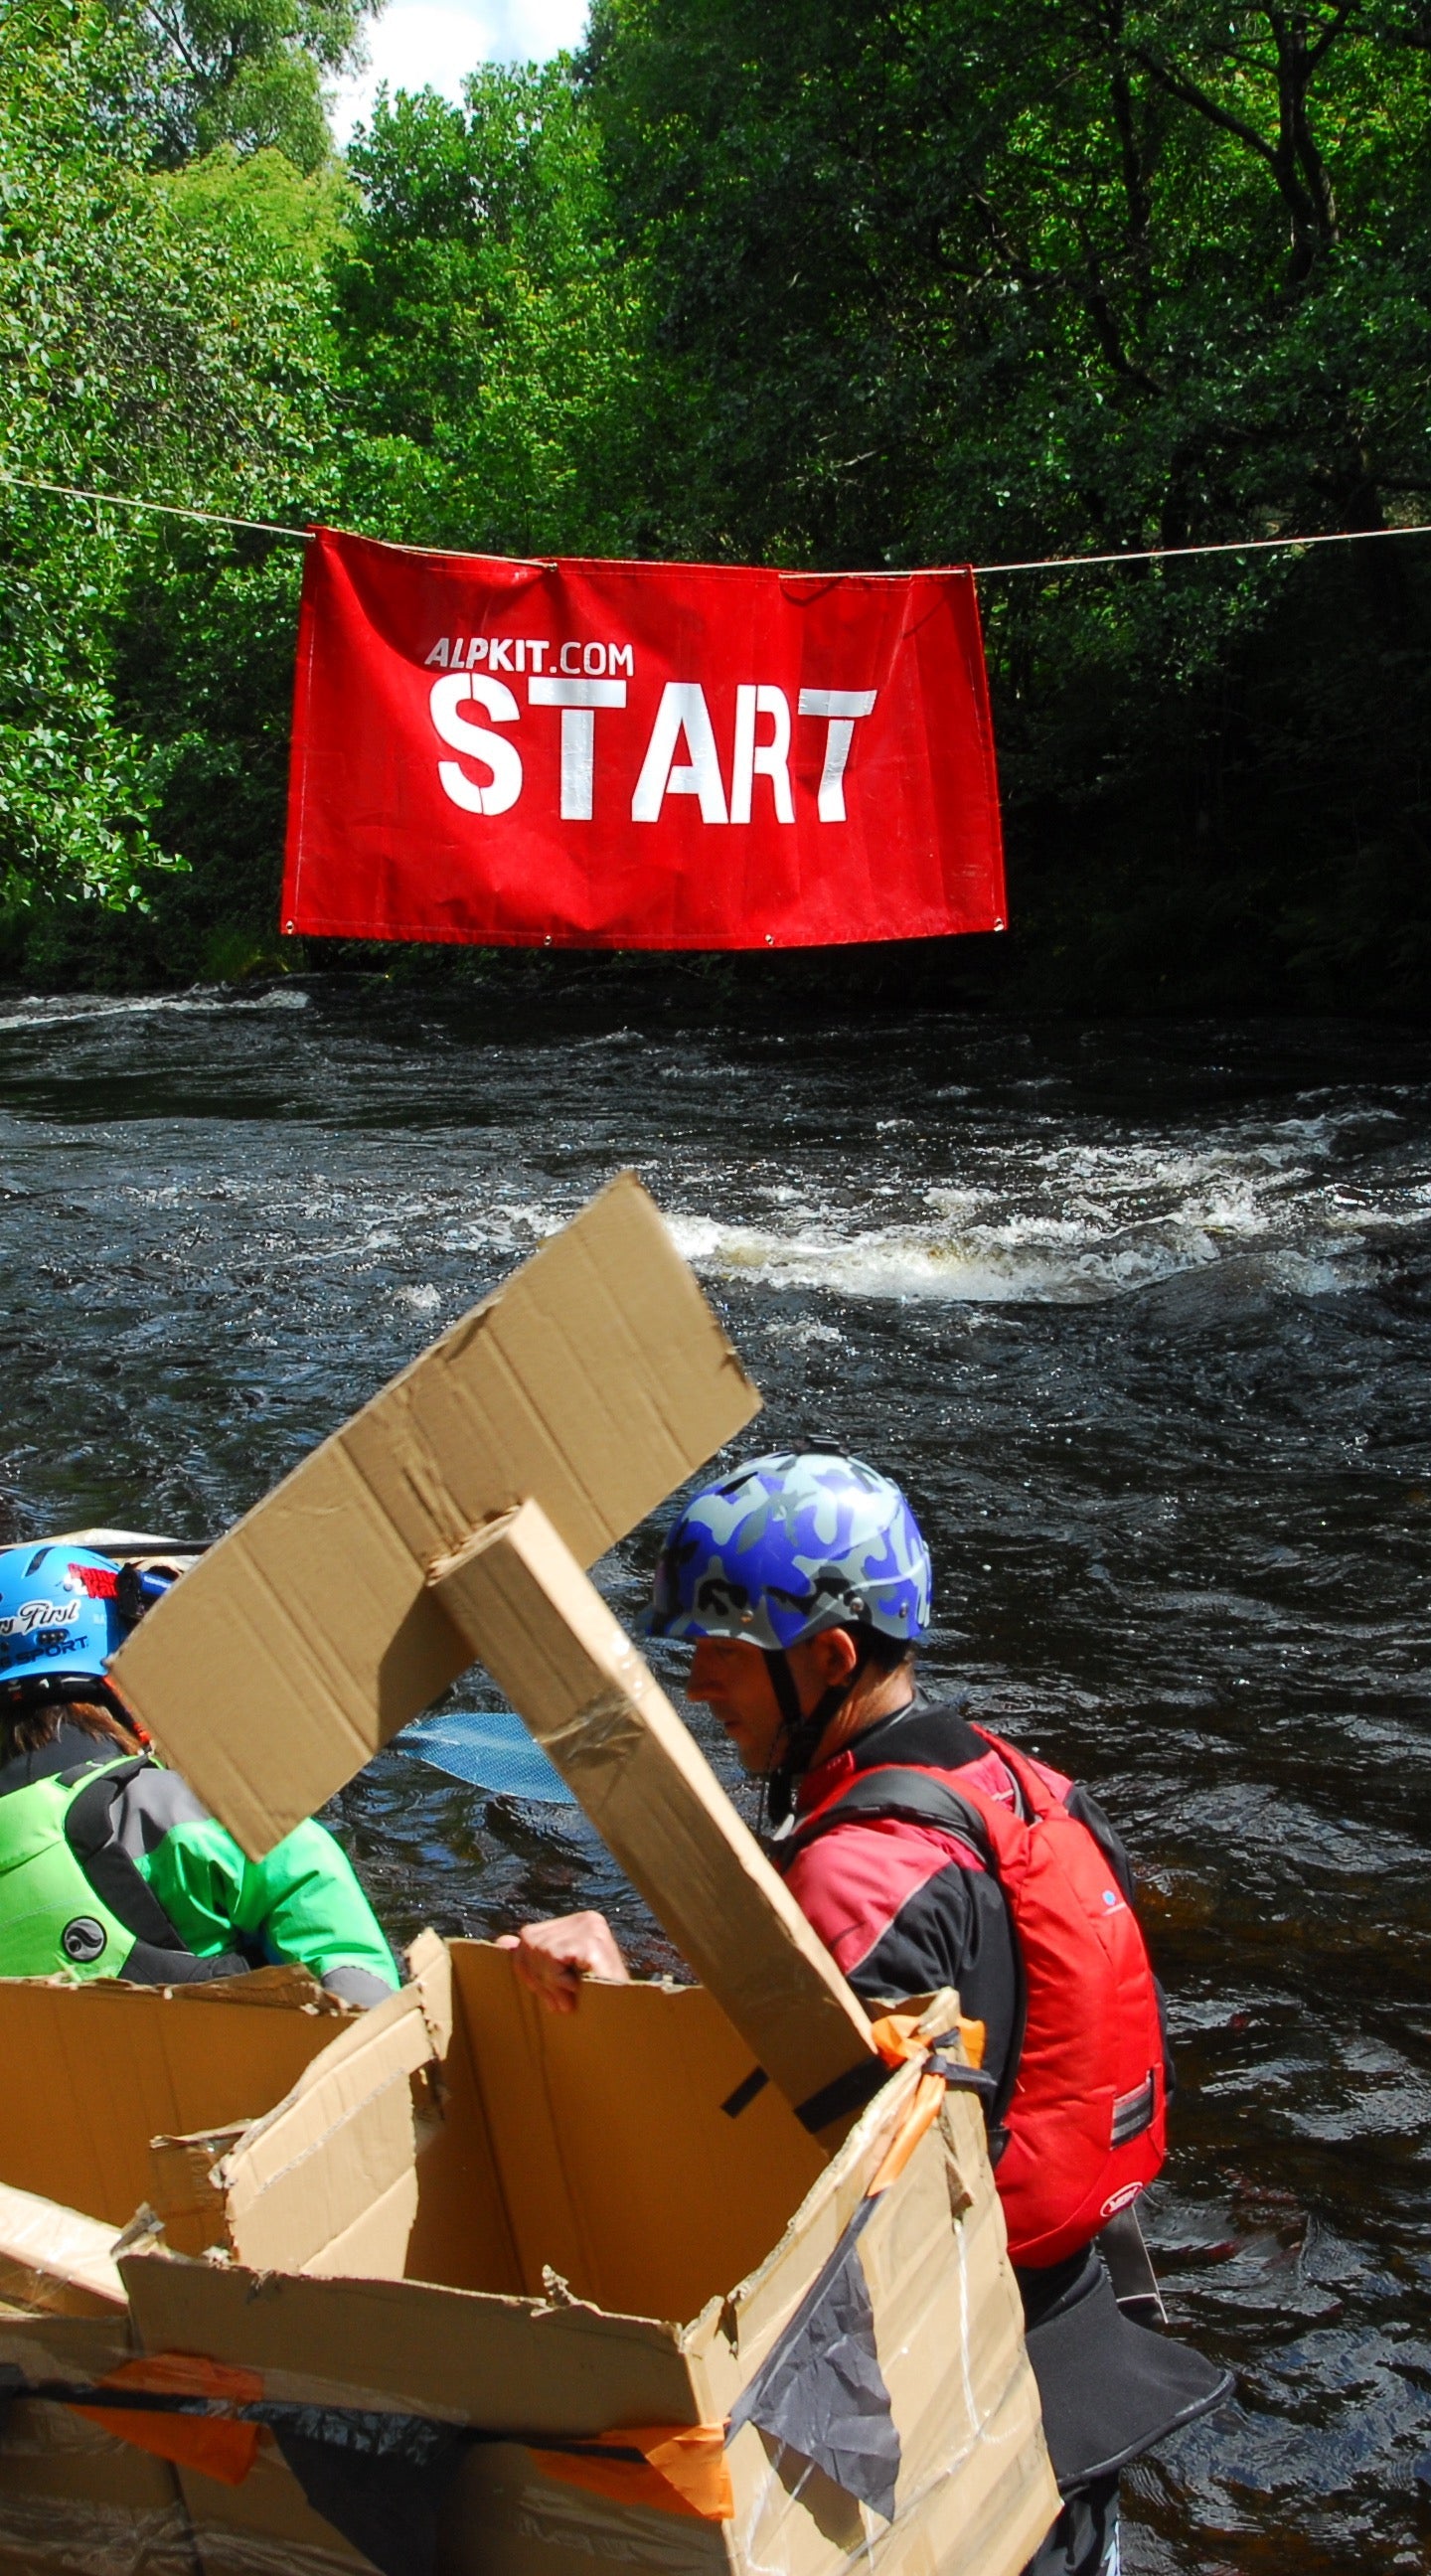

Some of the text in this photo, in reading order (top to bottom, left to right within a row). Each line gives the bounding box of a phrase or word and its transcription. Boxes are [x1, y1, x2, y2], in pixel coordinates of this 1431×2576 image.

[424, 637, 634, 677] ALPKIT.COM
[429, 672, 877, 824] START
[16, 1635, 87, 1665] SPORT
